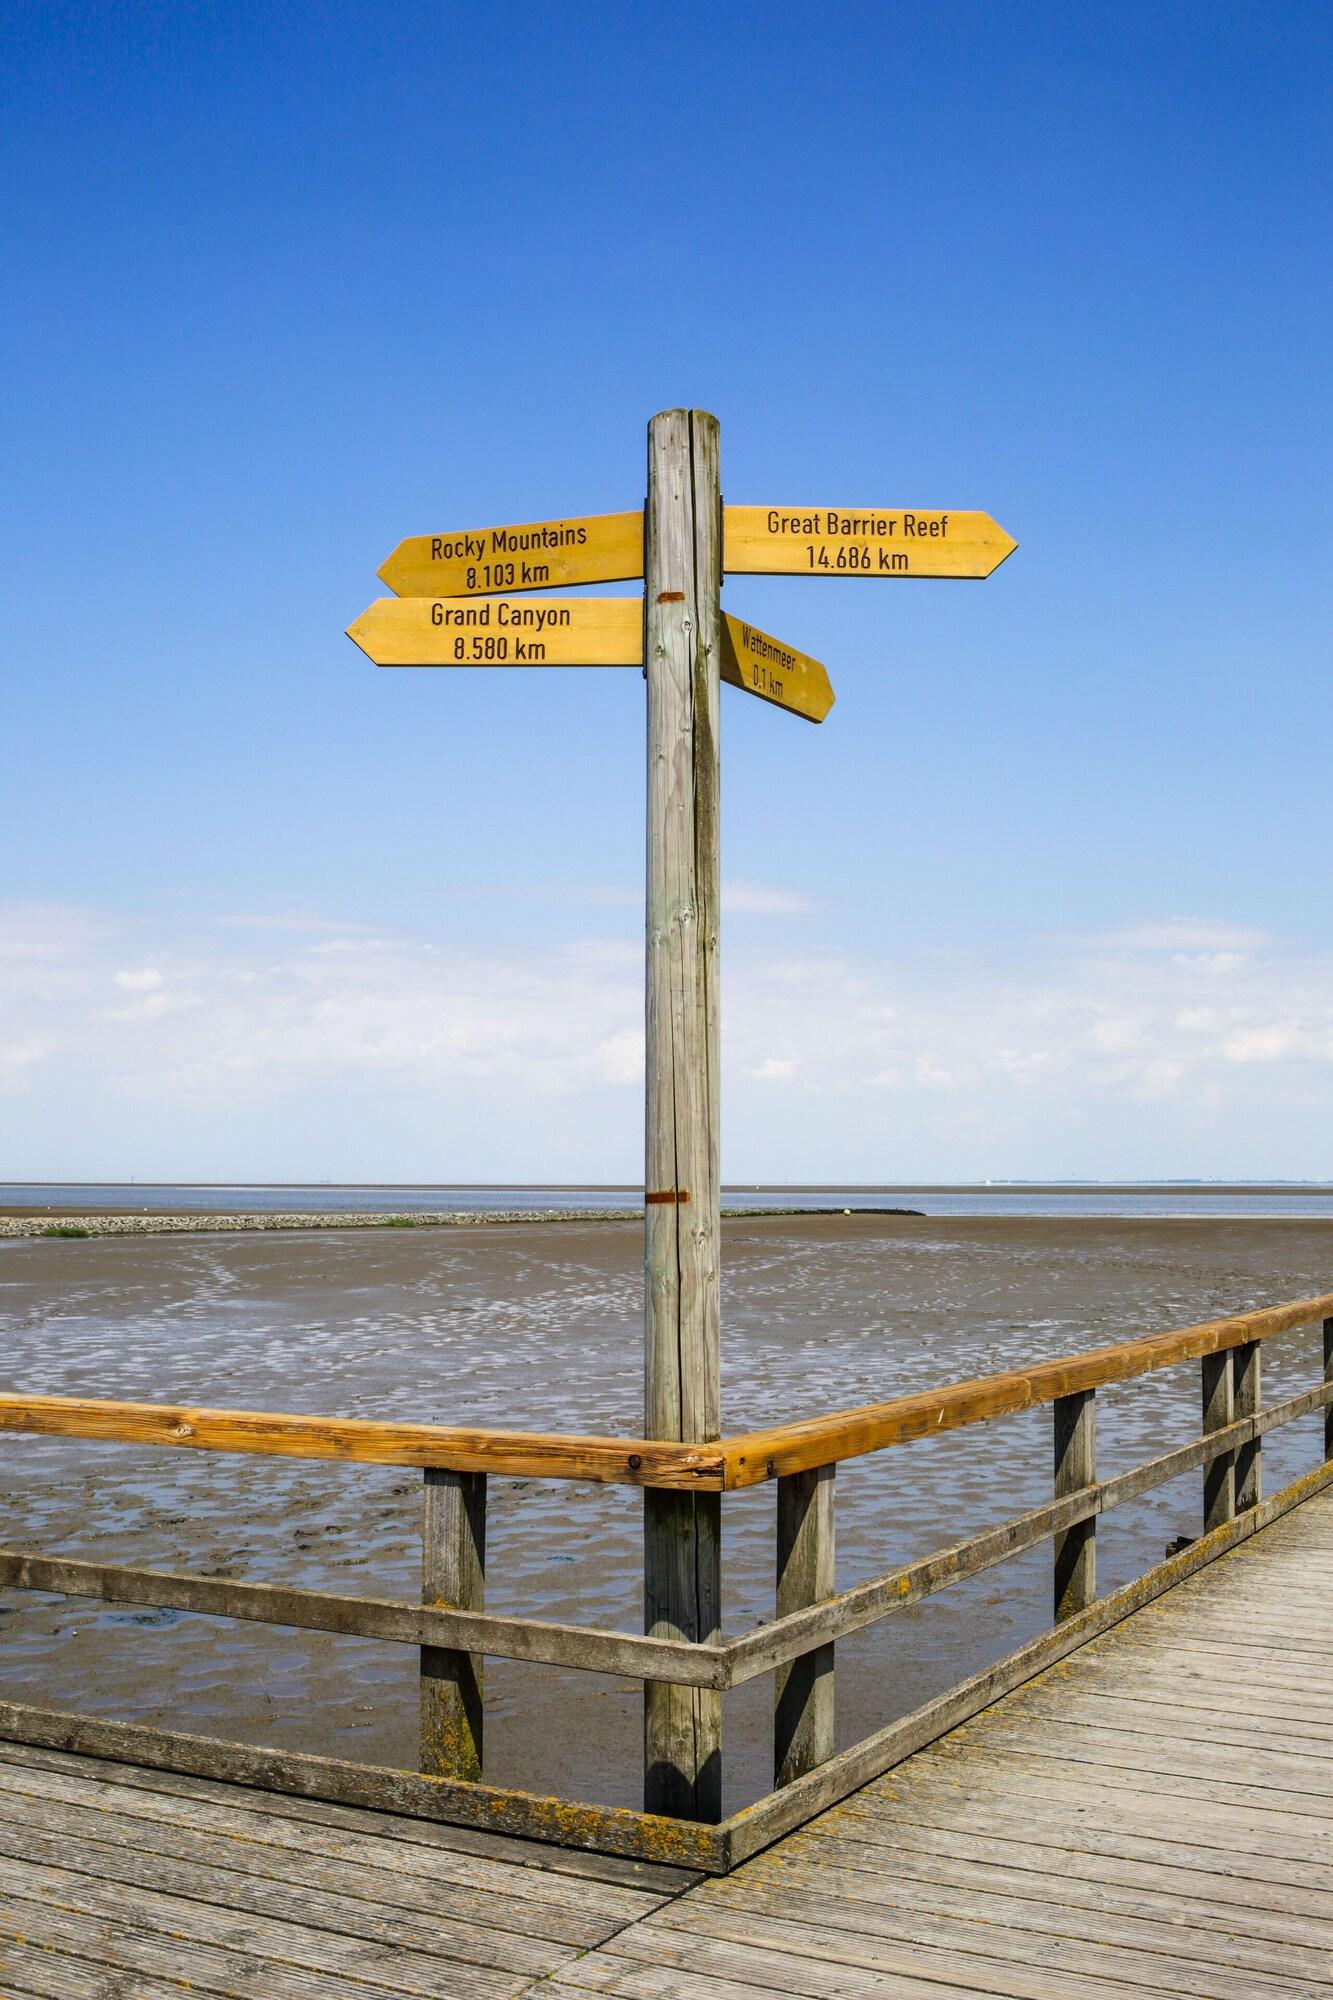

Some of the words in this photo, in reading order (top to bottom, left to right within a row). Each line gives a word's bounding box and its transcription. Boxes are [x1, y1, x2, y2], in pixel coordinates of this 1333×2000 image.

[767, 511, 821, 535] Great
[827, 512, 897, 537] Barrier
[903, 514, 948, 538] Reef
[431, 538, 486, 562] Rocky
[492, 524, 587, 553] Mountains
[806, 545, 871, 569] 14.686
[879, 547, 909, 570] km
[466, 563, 516, 590] 8.103
[521, 562, 549, 583] km
[431, 603, 490, 626] Grand
[497, 603, 571, 632] Canyon
[454, 637, 508, 660] 8.580
[515, 637, 545, 660] km
[742, 624, 796, 672] Wattenmeer
[753, 664, 766, 690] 0.1
[769, 672, 784, 698] km
